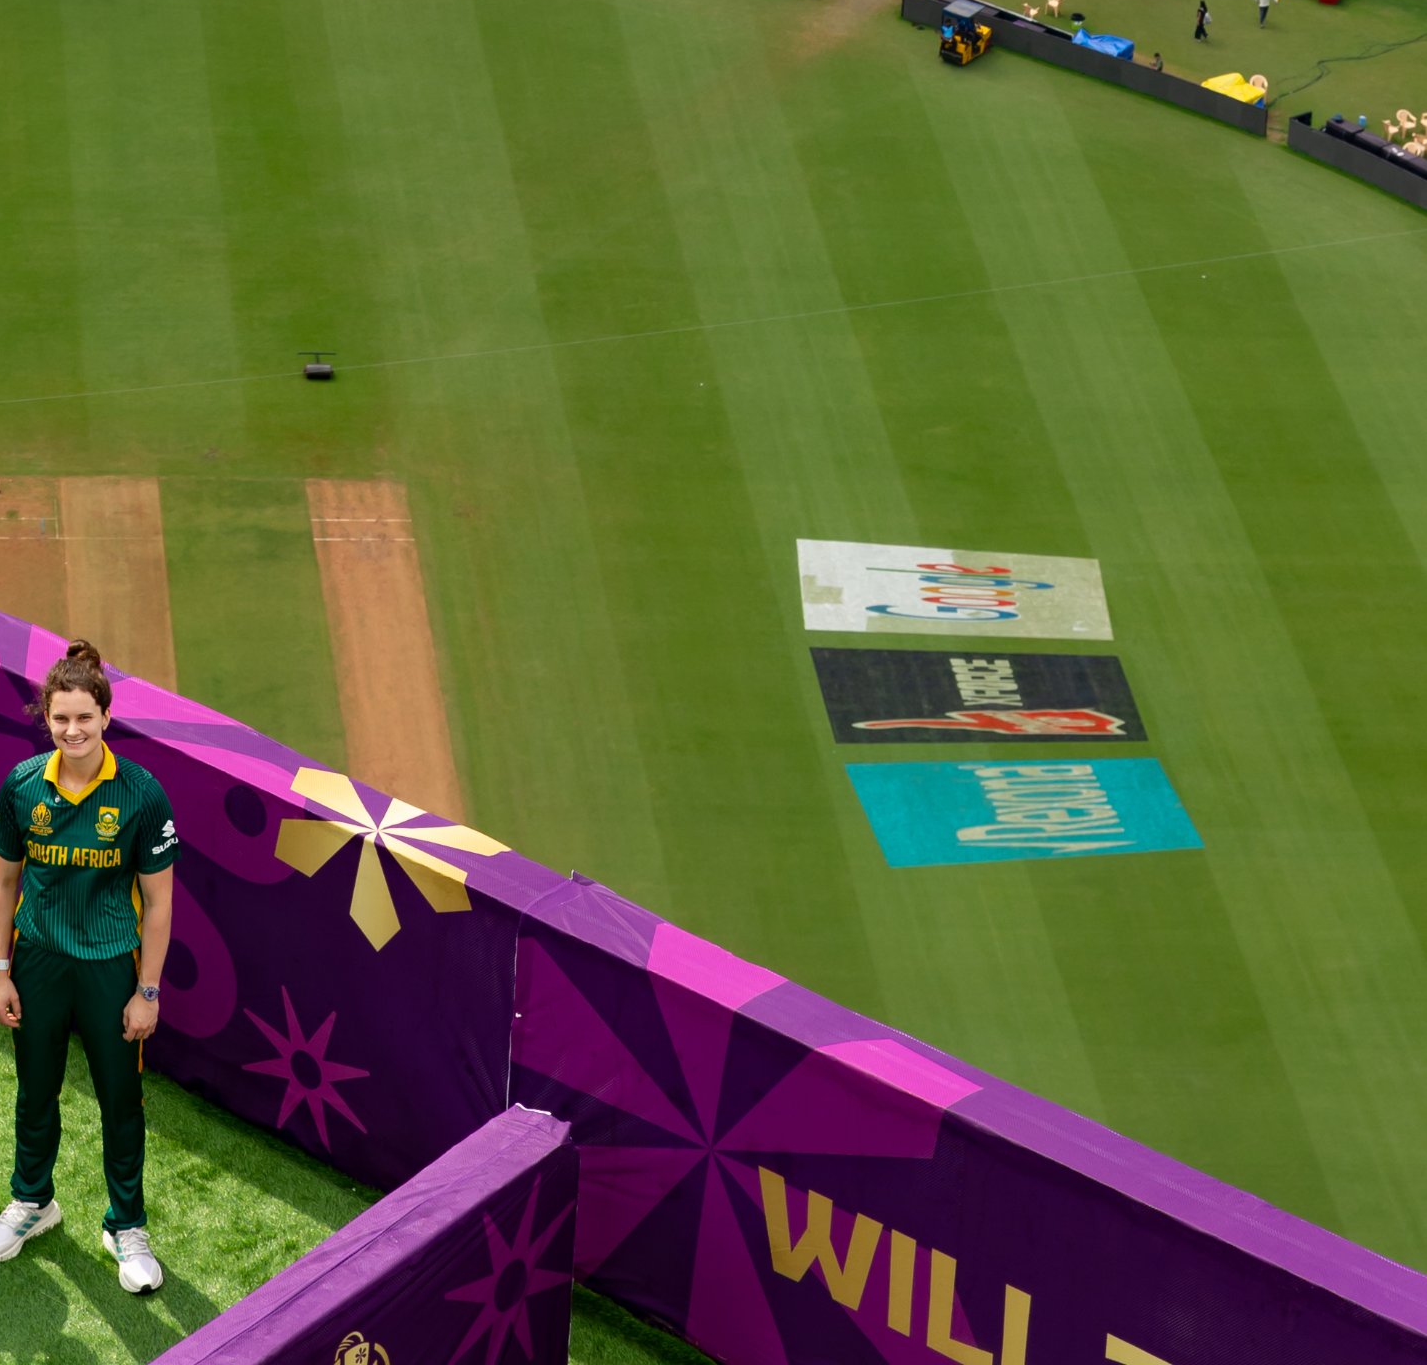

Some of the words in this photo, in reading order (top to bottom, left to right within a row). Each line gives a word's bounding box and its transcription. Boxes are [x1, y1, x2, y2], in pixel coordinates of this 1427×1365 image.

[865, 563, 1055, 621] Google
[956, 764, 1126, 842] Rexona
[27, 840, 68, 866] SOUTH
[71, 848, 122, 869] AFRICA
